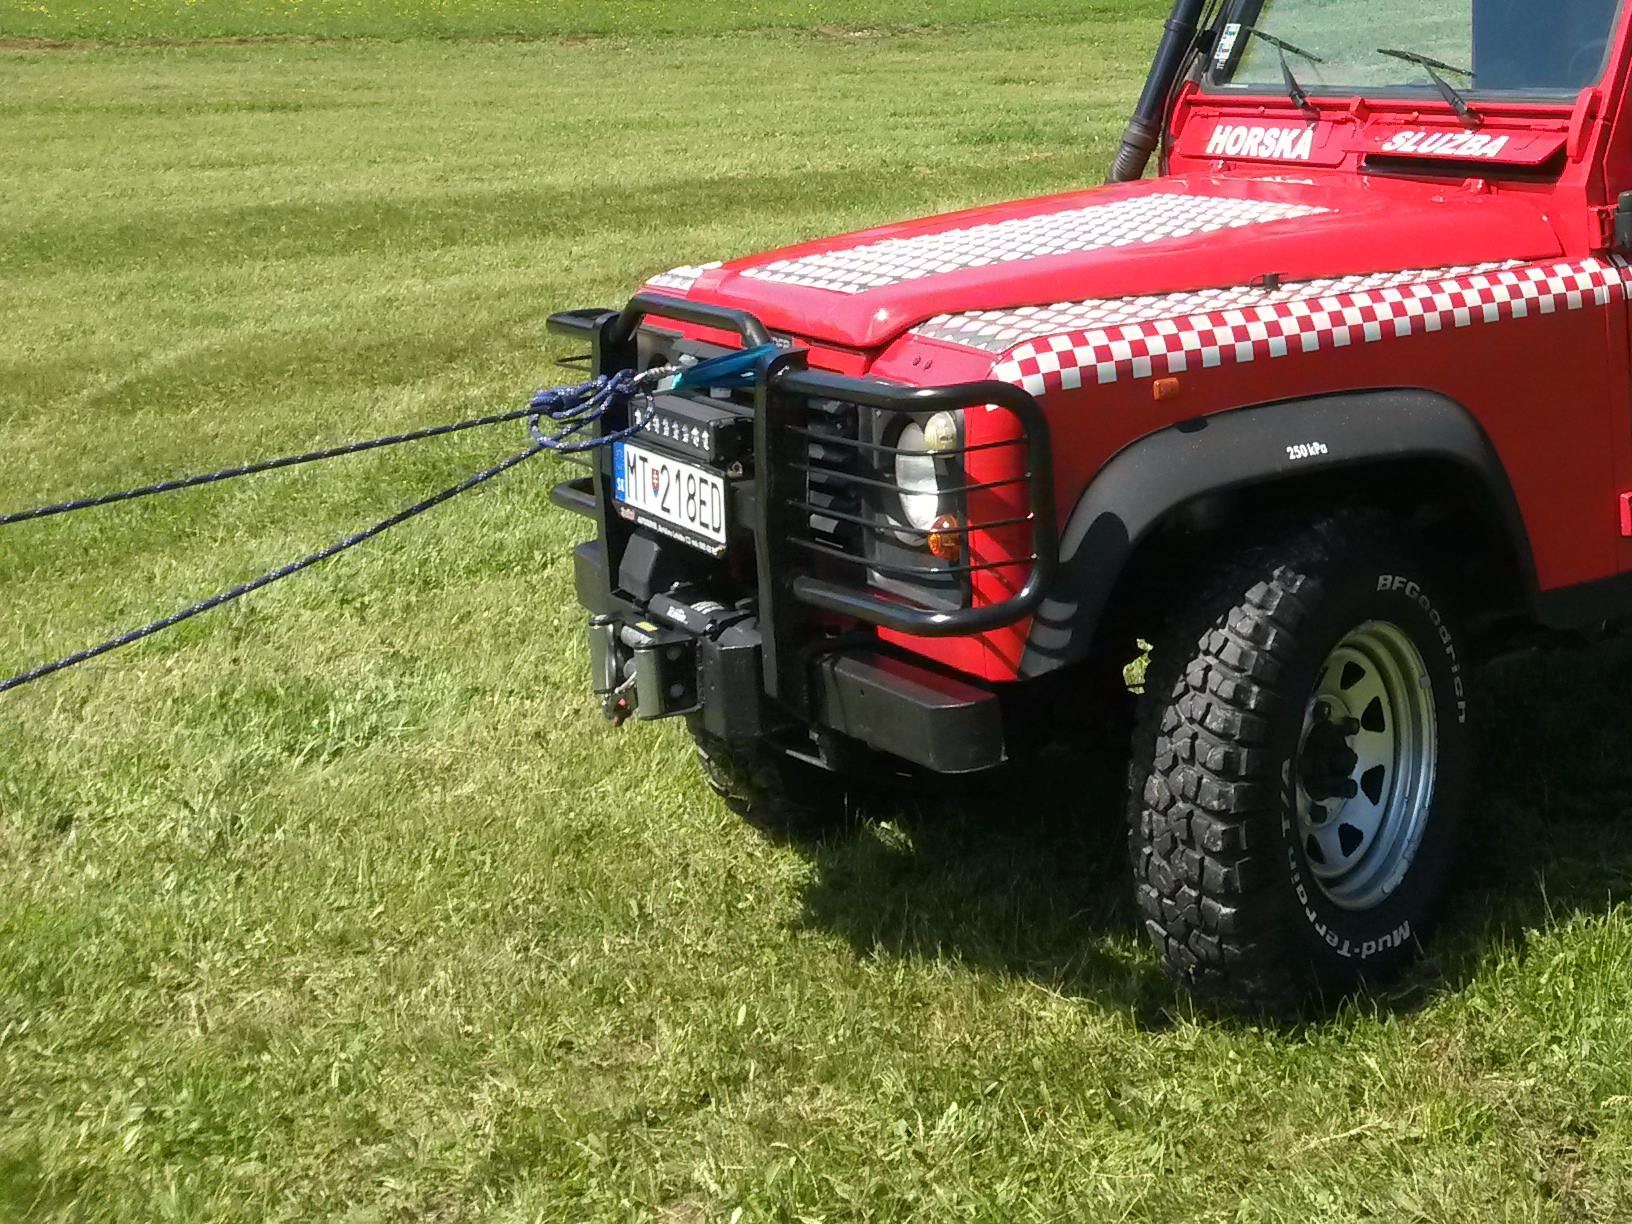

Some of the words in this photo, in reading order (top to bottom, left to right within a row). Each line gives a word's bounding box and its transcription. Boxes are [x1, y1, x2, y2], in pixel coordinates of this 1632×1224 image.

[1206, 122, 1312, 160] HORSKÁ
[1381, 129, 1509, 158] SLUŽBA
[626, 450, 649, 505] MT
[660, 464, 722, 534] 218ED
[1376, 573, 1468, 725] BFGoodrich
